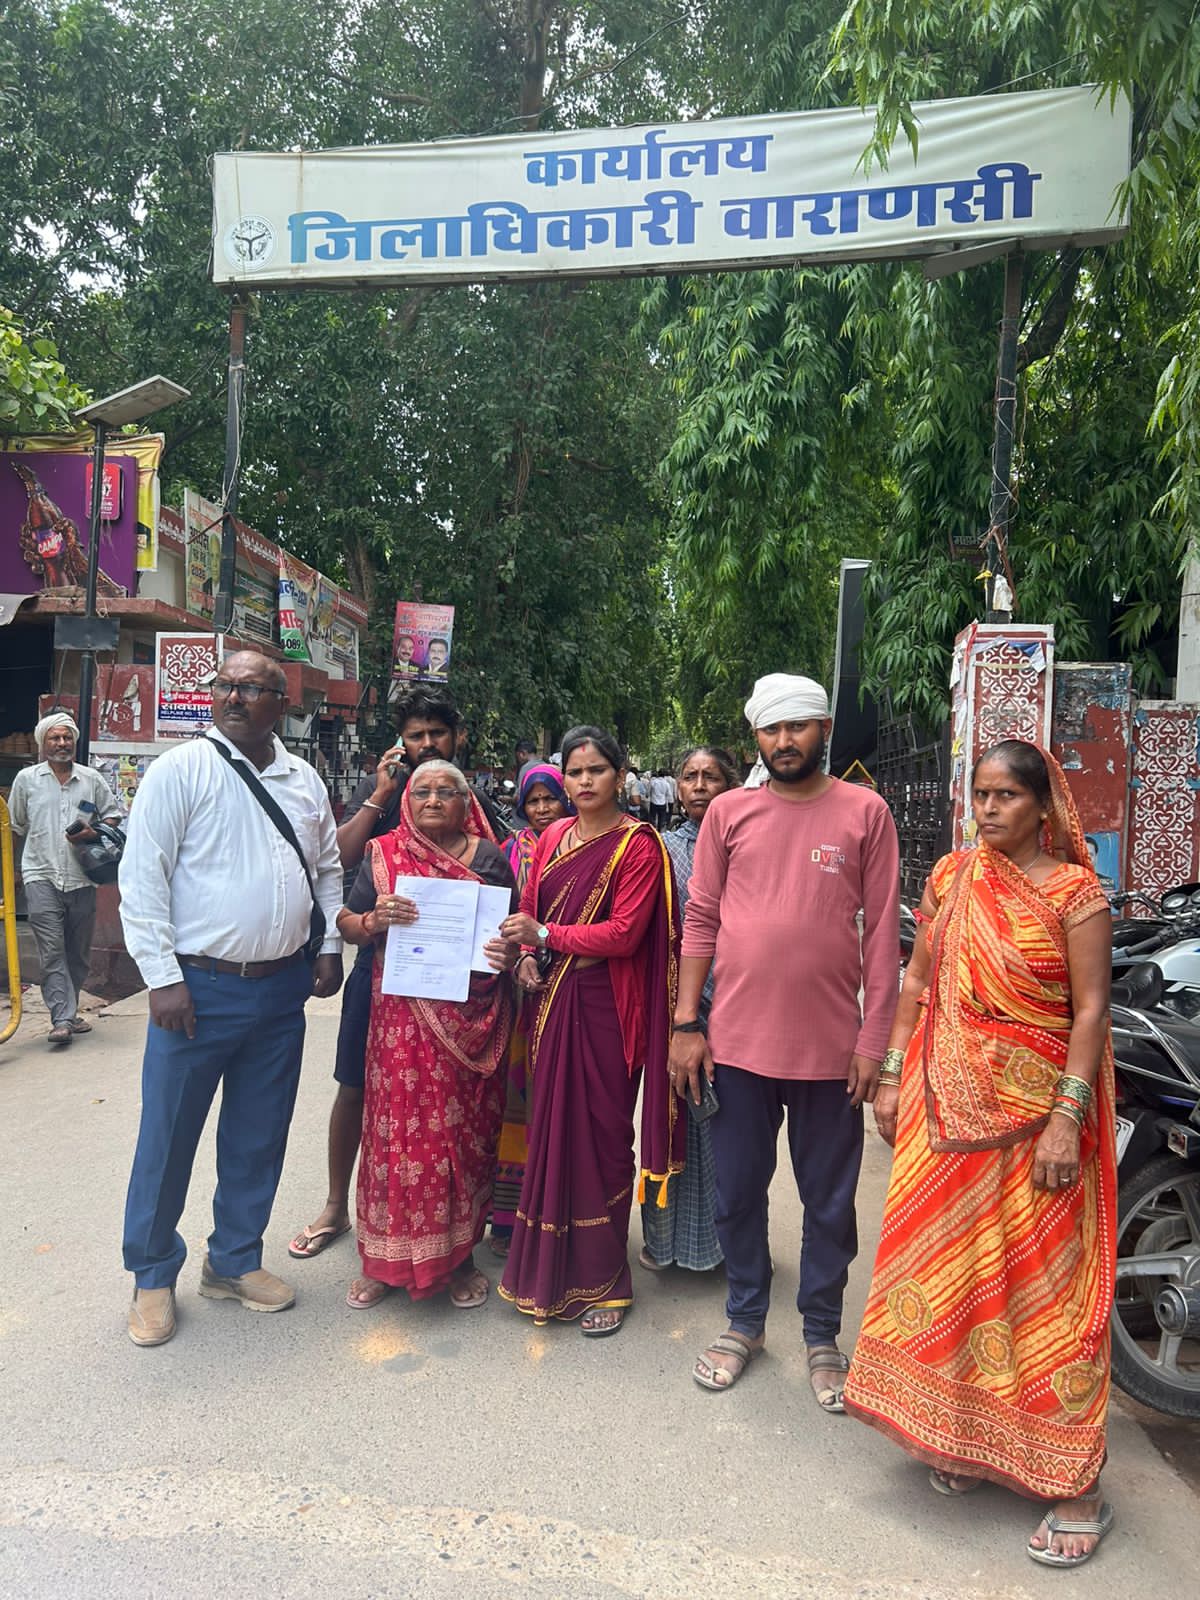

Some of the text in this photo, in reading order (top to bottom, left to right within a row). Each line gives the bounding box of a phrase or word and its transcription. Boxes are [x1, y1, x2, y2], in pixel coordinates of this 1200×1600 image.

[524, 129, 774, 187] कार्यालय
[287, 162, 1042, 264] जिलाधिकारी वाराणसी
[160, 702, 212, 711] सावधान
